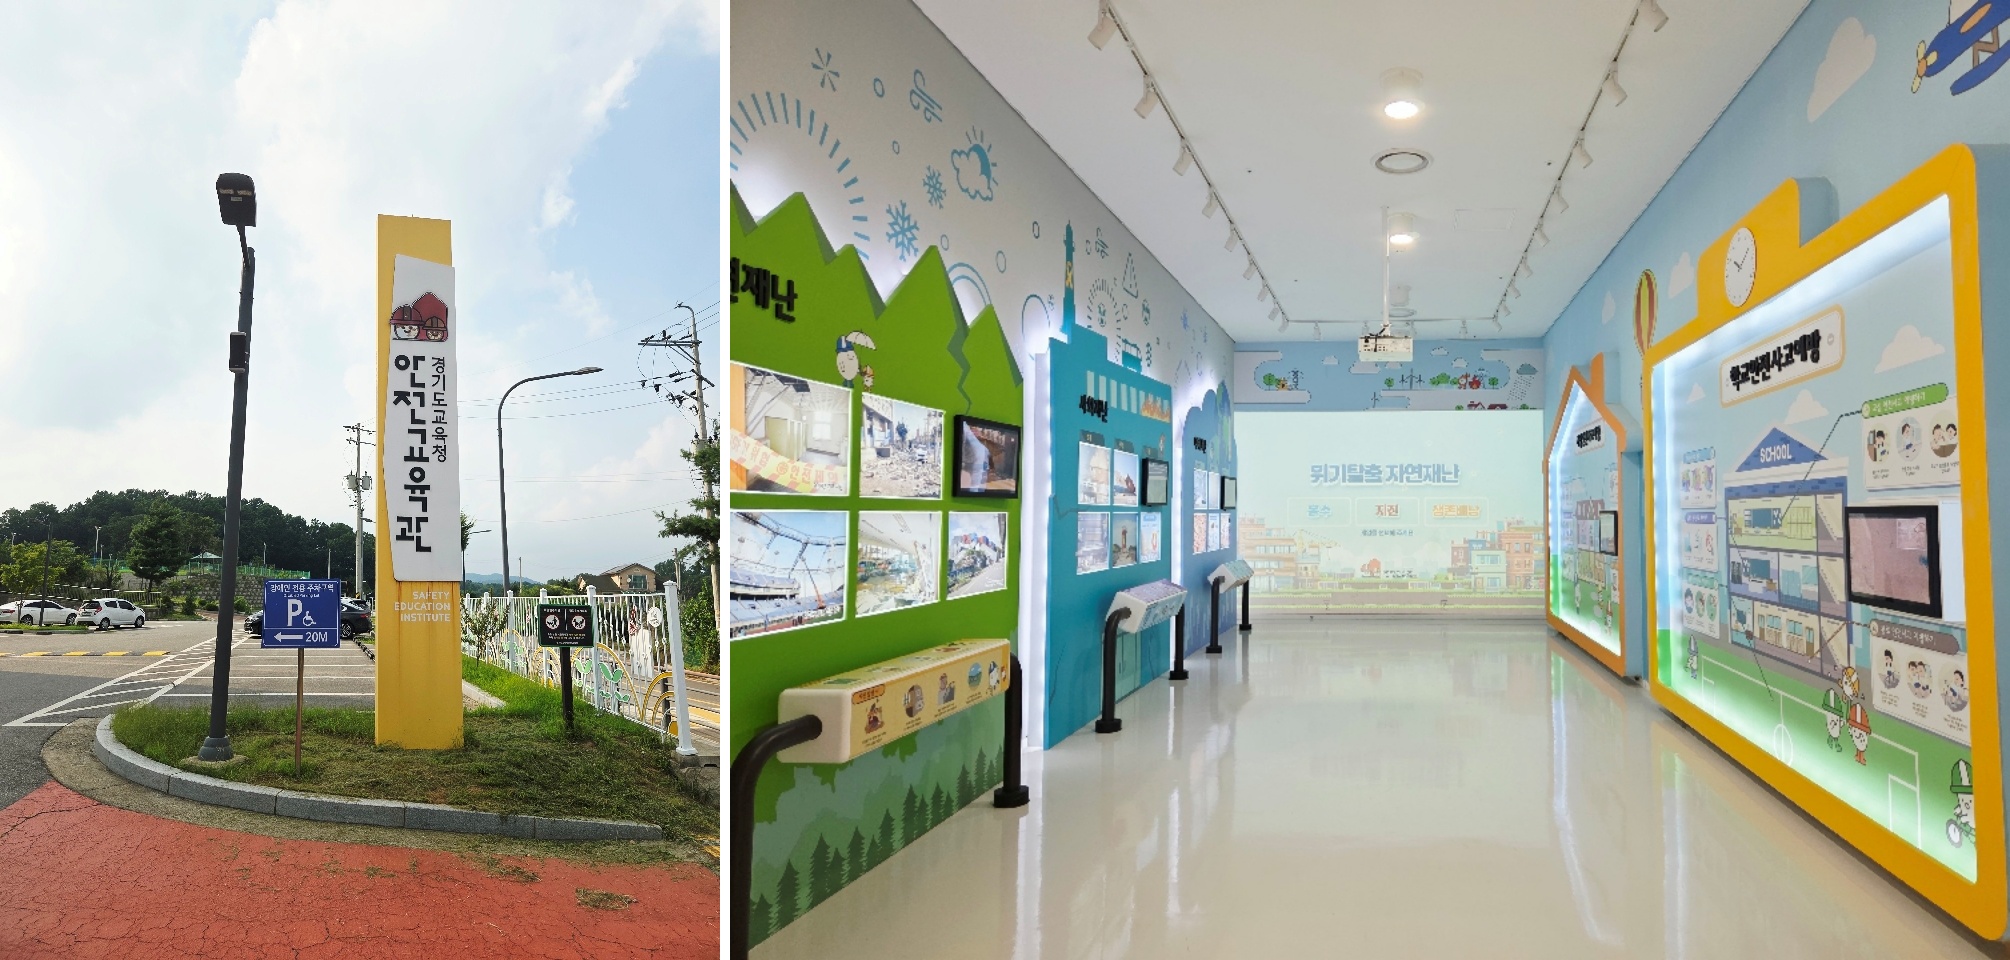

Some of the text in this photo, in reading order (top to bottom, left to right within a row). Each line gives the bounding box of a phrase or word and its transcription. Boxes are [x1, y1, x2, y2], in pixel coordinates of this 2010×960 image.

[1729, 328, 1822, 391] 학교안전사고예방
[430, 356, 448, 463] 경기도교육청
[391, 354, 433, 554] 안전교육관
[1759, 443, 1792, 463] SCHOOL
[1310, 463, 1460, 485] 위기탈출 자연재난
[1375, 503, 1399, 517] 지진
[412, 591, 450, 600] SAFETY
[287, 598, 303, 627] P
[394, 601, 451, 611] EDUCATION
[400, 612, 451, 622] INSTITUTE
[305, 631, 328, 643] 20M
